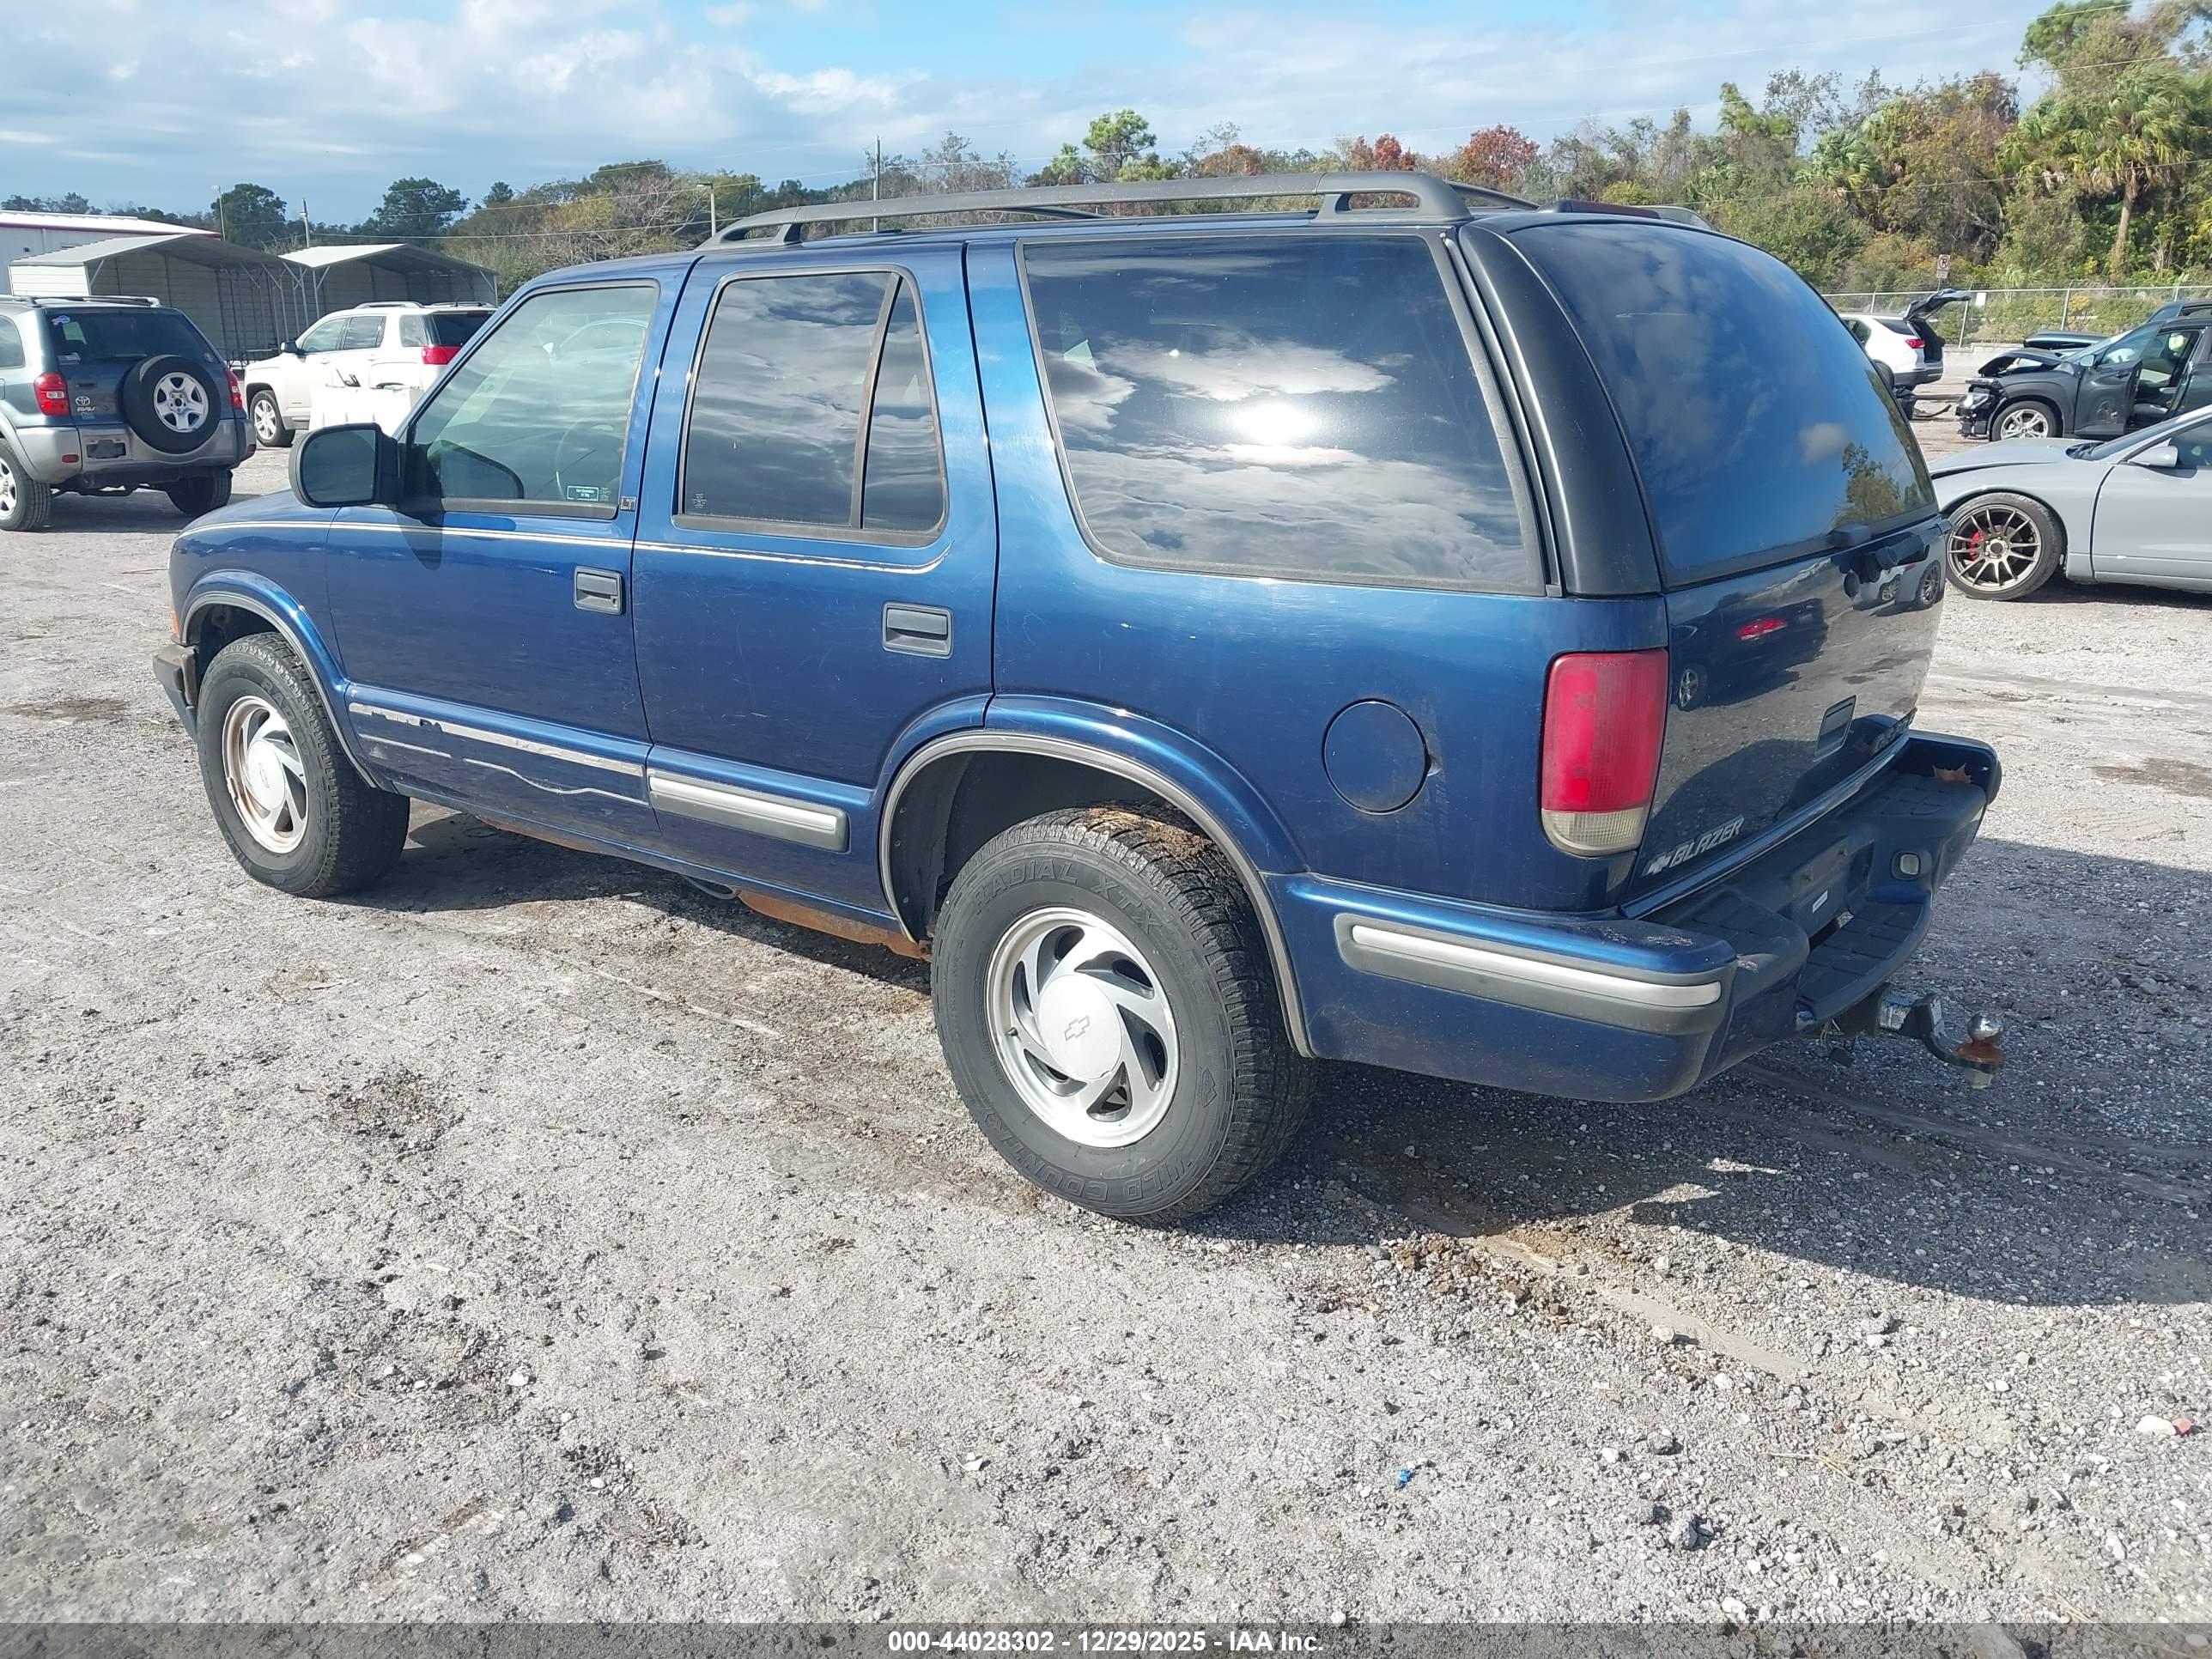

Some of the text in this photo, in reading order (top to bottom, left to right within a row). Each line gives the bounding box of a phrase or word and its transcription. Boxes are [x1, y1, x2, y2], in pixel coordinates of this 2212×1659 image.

[620, 498, 635, 511] LT
[1669, 816, 1745, 868] BLAZER
[972, 858, 1163, 935] RADIAL XTX
